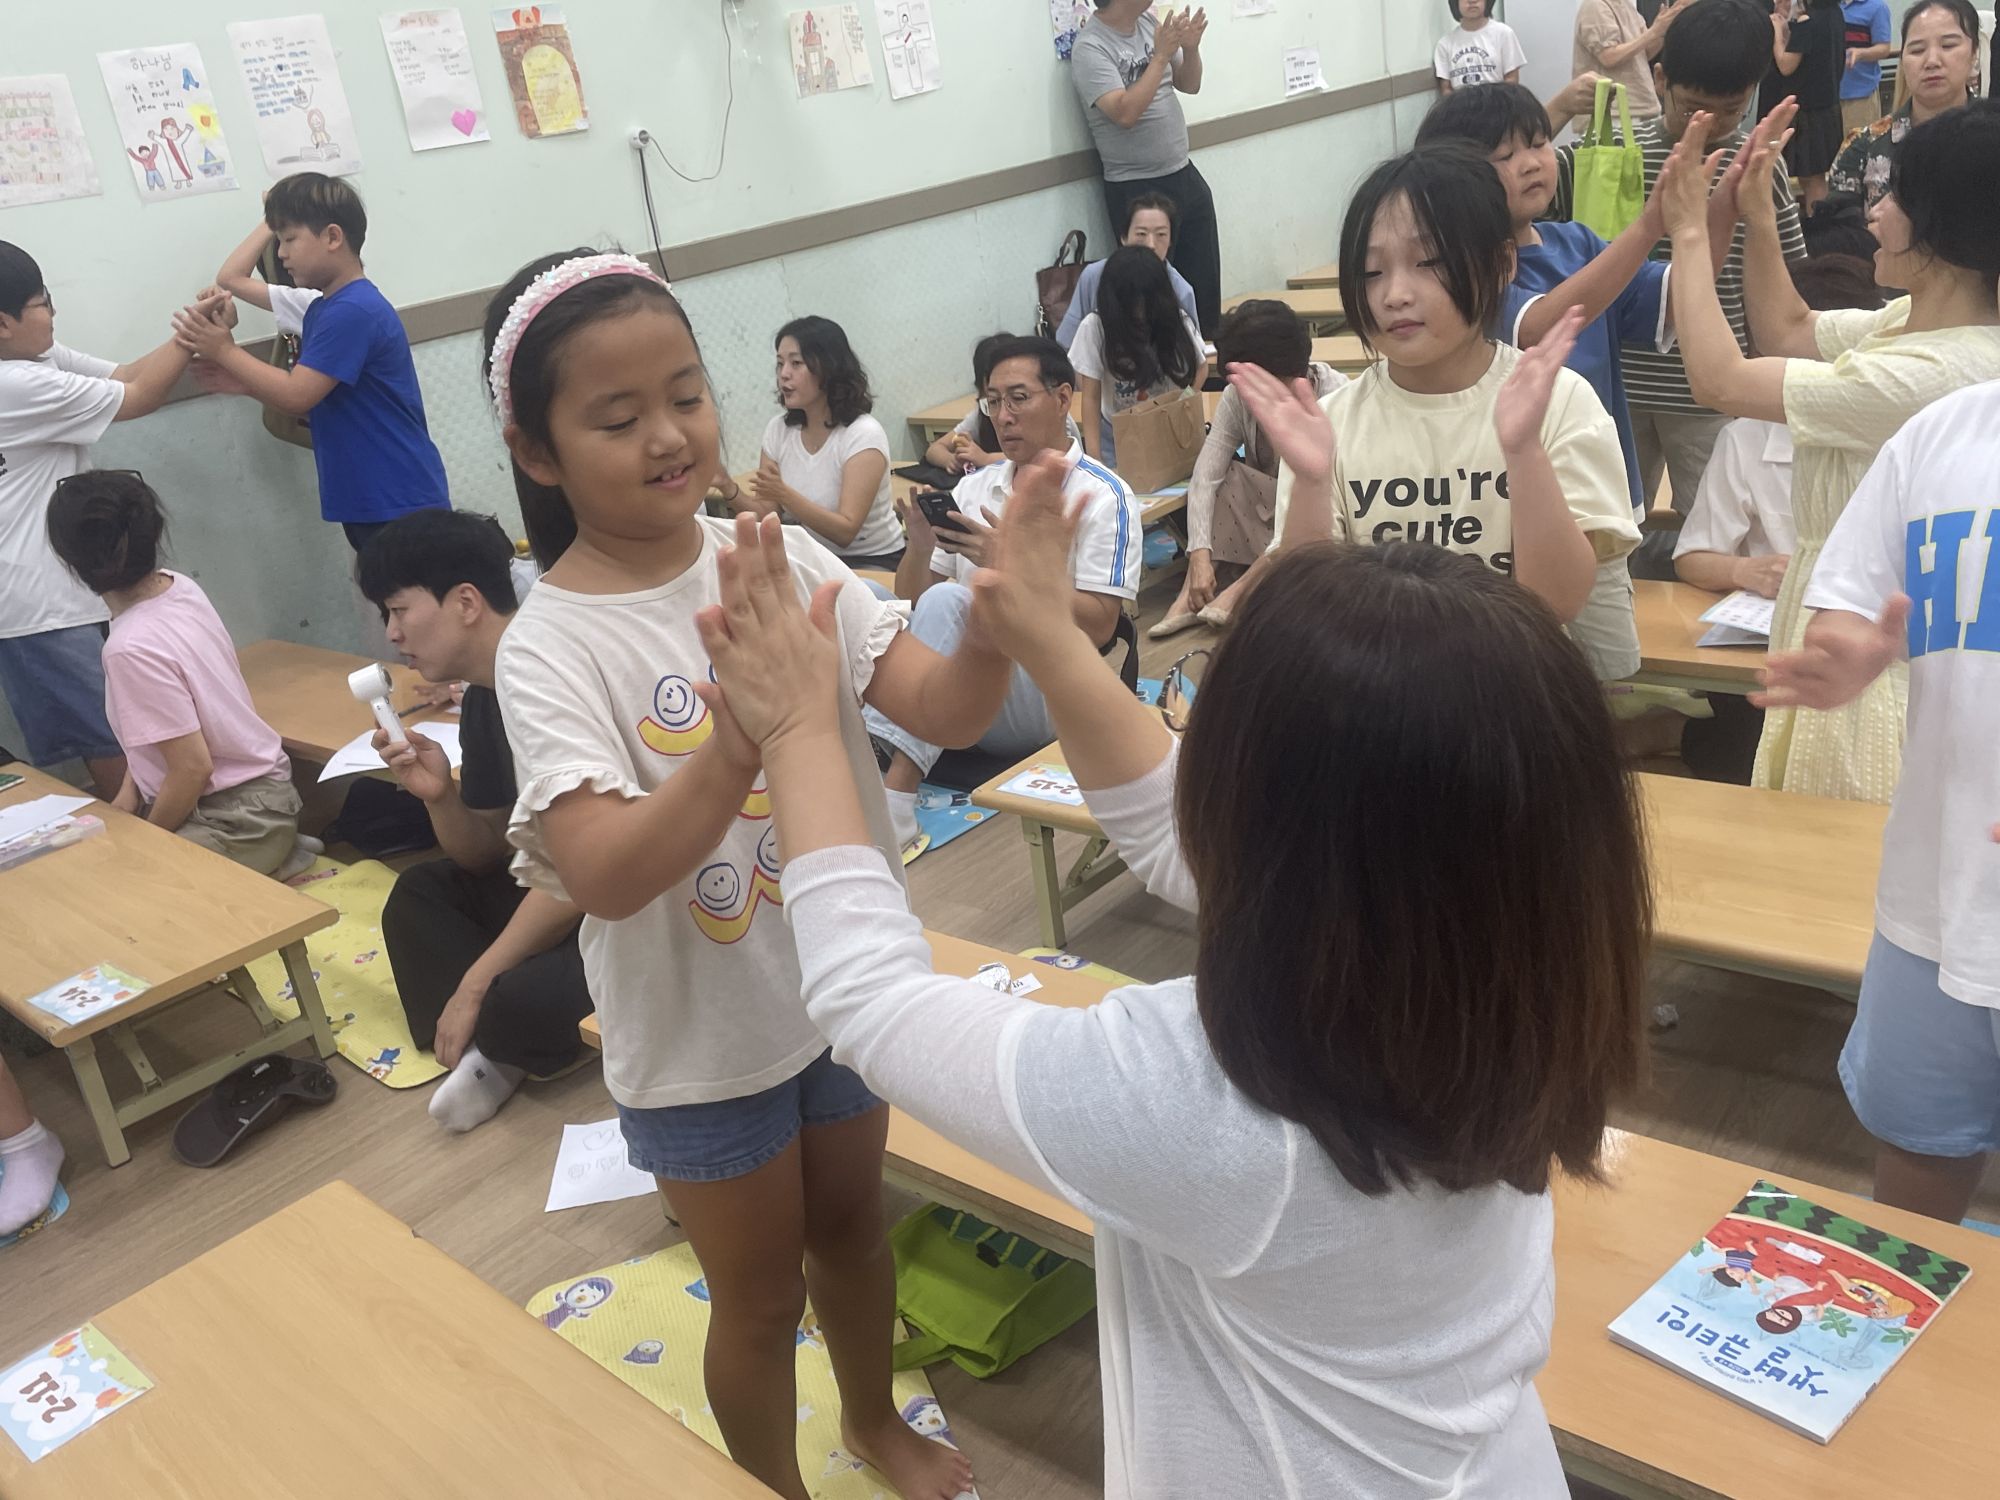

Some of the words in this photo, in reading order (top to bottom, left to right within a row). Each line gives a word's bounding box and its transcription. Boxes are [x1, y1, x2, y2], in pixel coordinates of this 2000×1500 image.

[130, 52, 172, 72] 하나님
[1371, 513, 1483, 547] cute
[1026, 779, 1079, 795] 2-15
[1656, 1304, 1751, 1360] 큐티인
[1754, 1346, 1829, 1397] 샛별
[19, 1371, 78, 1424] 2-11
